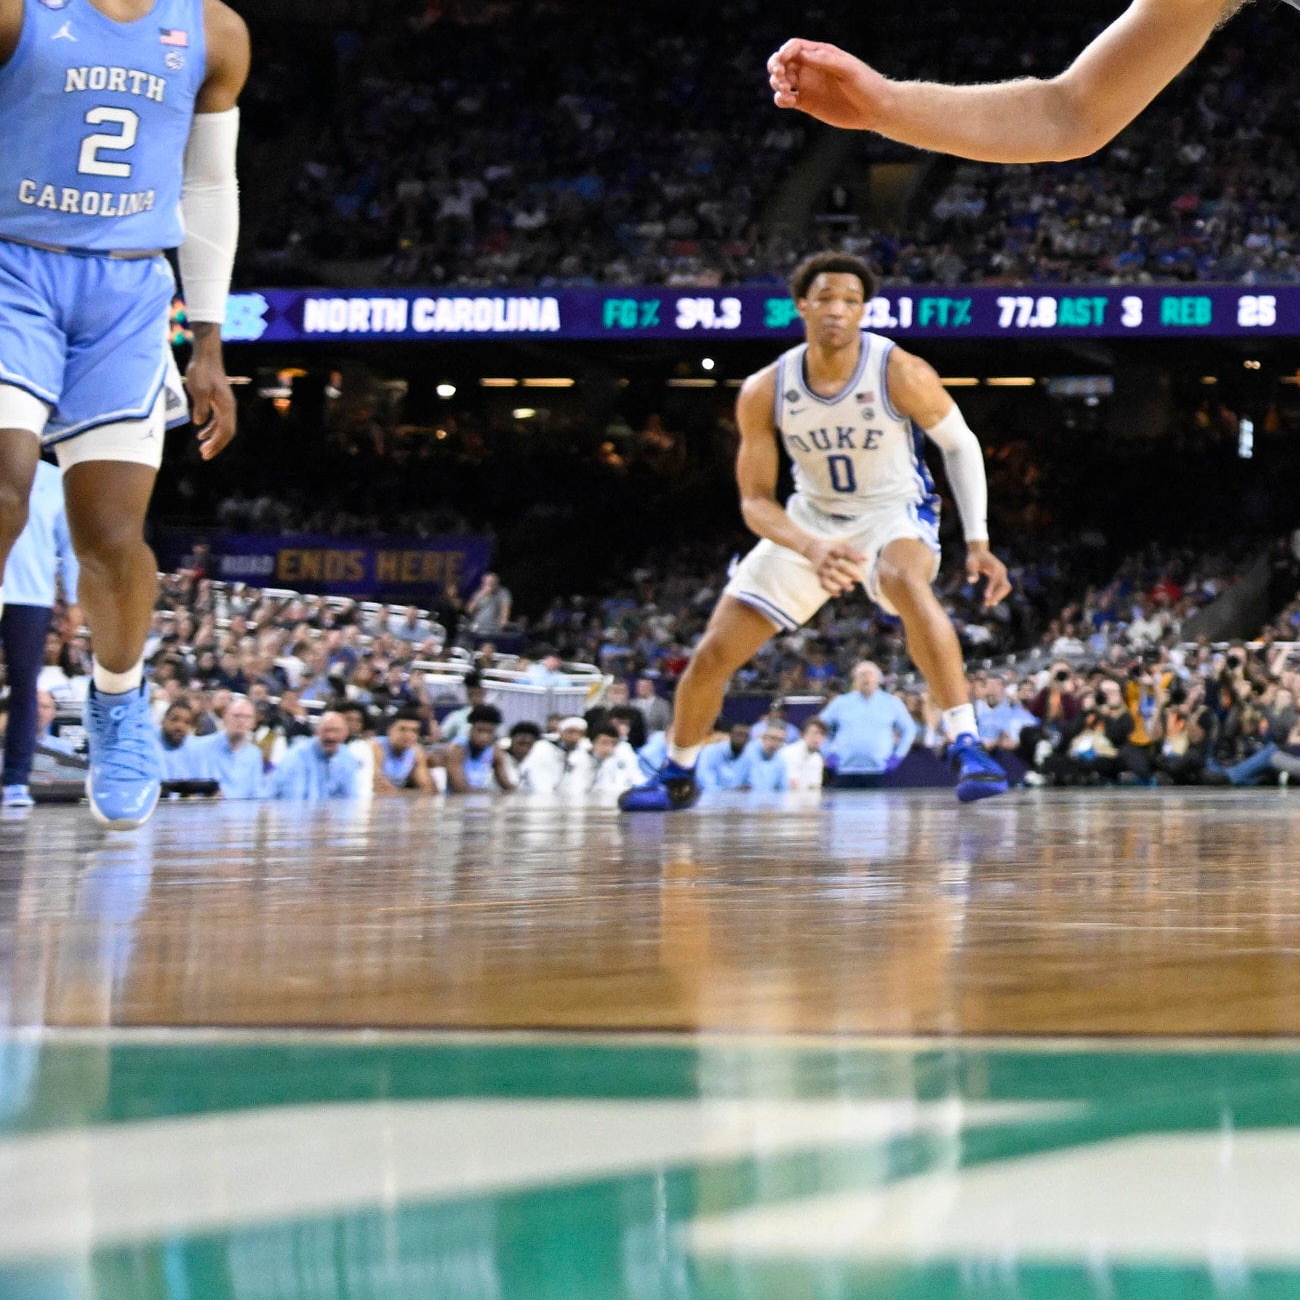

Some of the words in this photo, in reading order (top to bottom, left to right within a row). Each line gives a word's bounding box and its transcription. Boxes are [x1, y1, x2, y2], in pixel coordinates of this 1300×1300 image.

[63, 66, 167, 103] NORTH
[77, 105, 140, 179] 2
[17, 178, 157, 218] CAROLINA
[303, 297, 407, 333] NORTH
[411, 297, 560, 333] CAROLINA
[675, 297, 742, 330] 34.3
[998, 296, 1057, 329] 77.8
[1057, 297, 1108, 327] AST
[1121, 296, 1143, 328] 3
[1160, 297, 1212, 326] REB
[1237, 295, 1277, 327] 25
[787, 425, 884, 454] DUKE
[828, 454, 858, 494] 0
[277, 548, 366, 583] ENDS
[374, 550, 468, 584] HERE
